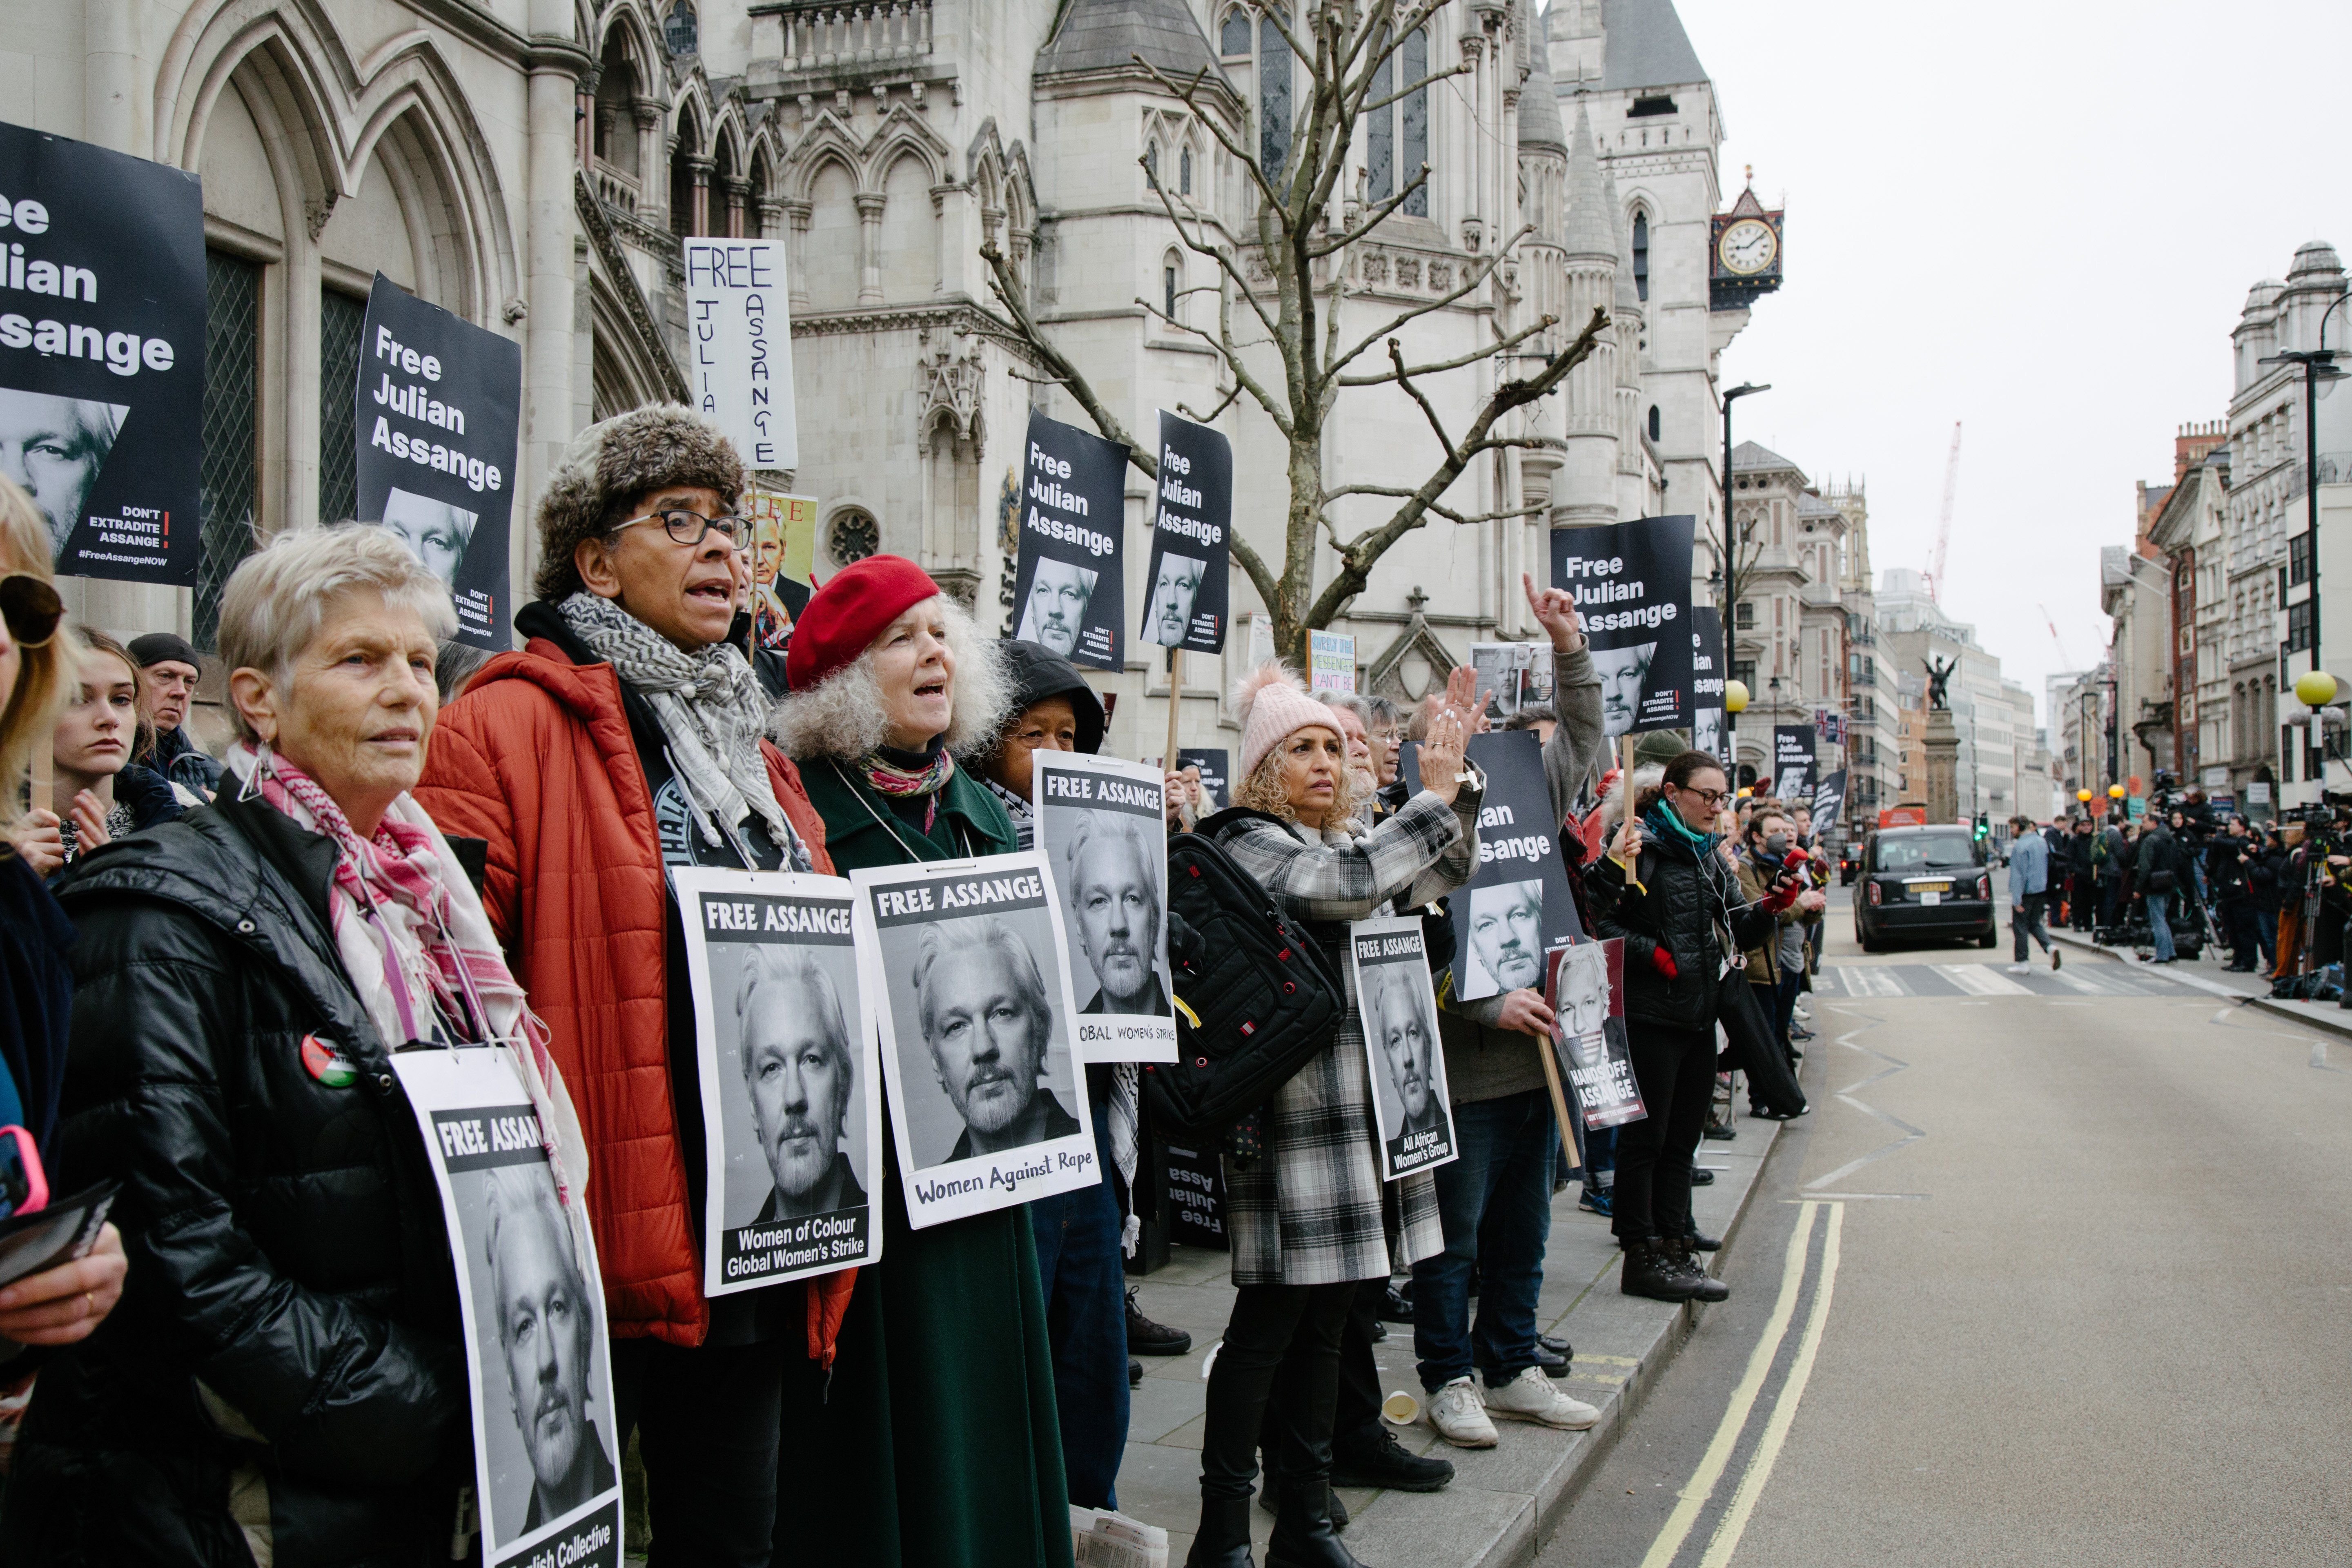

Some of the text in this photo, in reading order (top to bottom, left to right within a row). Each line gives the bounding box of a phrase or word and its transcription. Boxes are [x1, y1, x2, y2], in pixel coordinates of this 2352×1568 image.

[689, 247, 772, 287] FREE
[376, 325, 441, 381] Free
[746, 294, 775, 463] ASSANGE
[374, 373, 465, 435] Julian
[372, 416, 502, 492] Assange
[1031, 441, 1071, 479] Free
[1164, 443, 1190, 475] Free
[1029, 476, 1088, 516] Julian
[1161, 475, 1201, 509] Julian
[122, 506, 160, 520] DON'T
[89, 517, 160, 534] EXTRADITE
[1027, 506, 1114, 556] Assange
[1158, 505, 1221, 546] Assange
[99, 532, 160, 548] ASSANGE
[78, 550, 167, 566] #FreeAssangeNOW
[1566, 557, 1623, 578] Free
[455, 594, 488, 613] EXTRADITE
[470, 588, 488, 602] DON'T
[1573, 580, 1644, 605] Julian
[459, 607, 488, 623] ASSANGE
[1192, 619, 1214, 628] EXTRADITE
[1577, 603, 1677, 633] Assange
[1083, 631, 1109, 643] EXTRADITE
[1095, 626, 1109, 635] DON'T
[1194, 626, 1214, 635] ASSANGE
[1086, 639, 1109, 651] ASSANGE
[1312, 635, 1354, 654] SURELY THE
[1312, 654, 1355, 673] MESSENGER
[1343, 676, 1352, 691] BE
[1643, 697, 1674, 707] EXTRADITE
[1646, 704, 1674, 713] ASSANGE
[1777, 733, 1797, 744] Free
[1777, 743, 1804, 753] Julian
[1777, 753, 1813, 764] Assange
[1047, 775, 1160, 811] FREE ASSANGE
[877, 875, 1042, 917] FREE ASSANGE
[705, 902, 851, 934] FREE ASSANGE
[1357, 935, 1421, 959] FREE ASSANGE
[1555, 935, 1570, 944] DON'T
[1117, 1023, 1154, 1040] WOMEN'S
[1156, 1027, 1176, 1041] STRIKE
[1570, 1059, 1627, 1086] HANDS OFF
[1579, 1078, 1636, 1108] ASSANGE
[438, 1119, 488, 1157] FREE
[1404, 1131, 1438, 1152] All African
[1394, 1142, 1448, 1169] Women's Group
[915, 1152, 1092, 1205] Women Against Rape
[738, 1216, 856, 1251] Women of Colour
[1181, 1210, 1223, 1234] Free
[727, 1237, 864, 1277] Global Women's Strike
[557, 1525, 610, 1568] Collective
